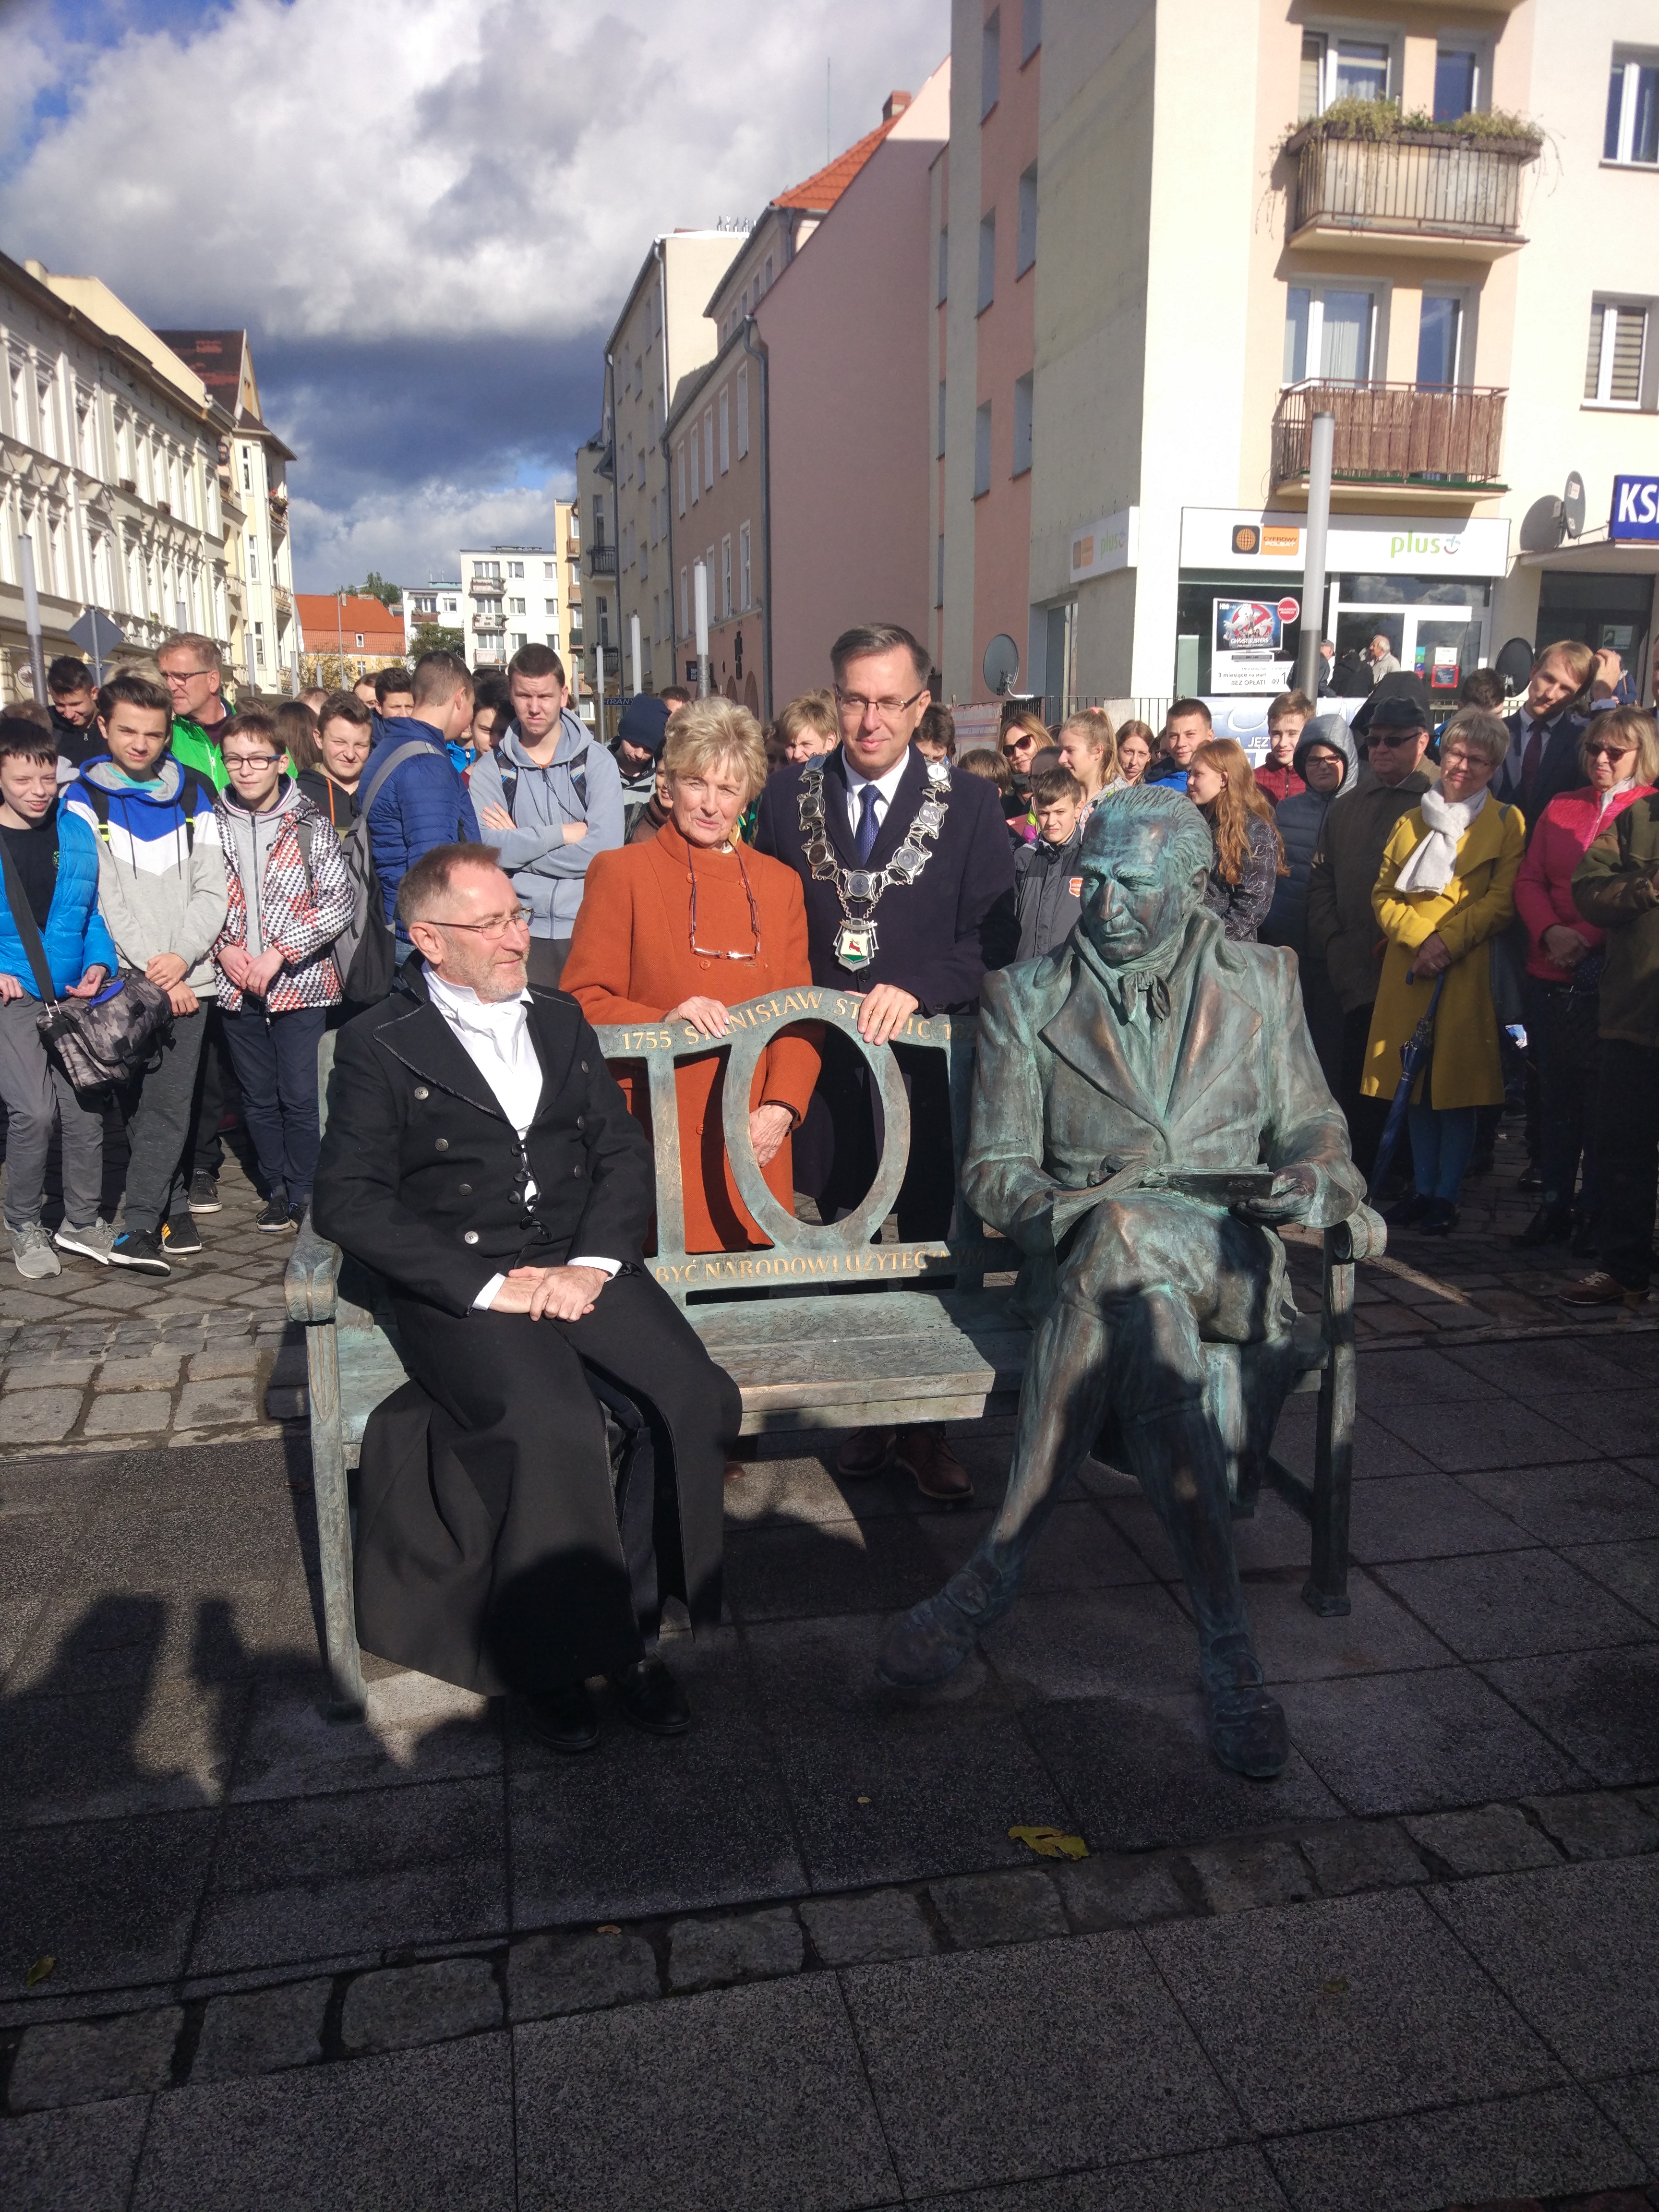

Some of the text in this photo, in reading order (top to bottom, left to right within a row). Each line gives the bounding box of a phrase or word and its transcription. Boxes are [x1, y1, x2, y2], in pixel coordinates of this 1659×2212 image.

[1618, 483, 1659, 524] KS
[1101, 529, 1118, 561] plus
[1391, 530, 1440, 558] plus
[1248, 737, 1271, 749] JĘZ
[621, 1031, 672, 1050] 1755
[684, 992, 822, 1045] SNISŁAW
[833, 998, 931, 1039] STIC
[655, 1258, 698, 1285] BYĆ
[704, 1256, 839, 1281] NARODOWI
